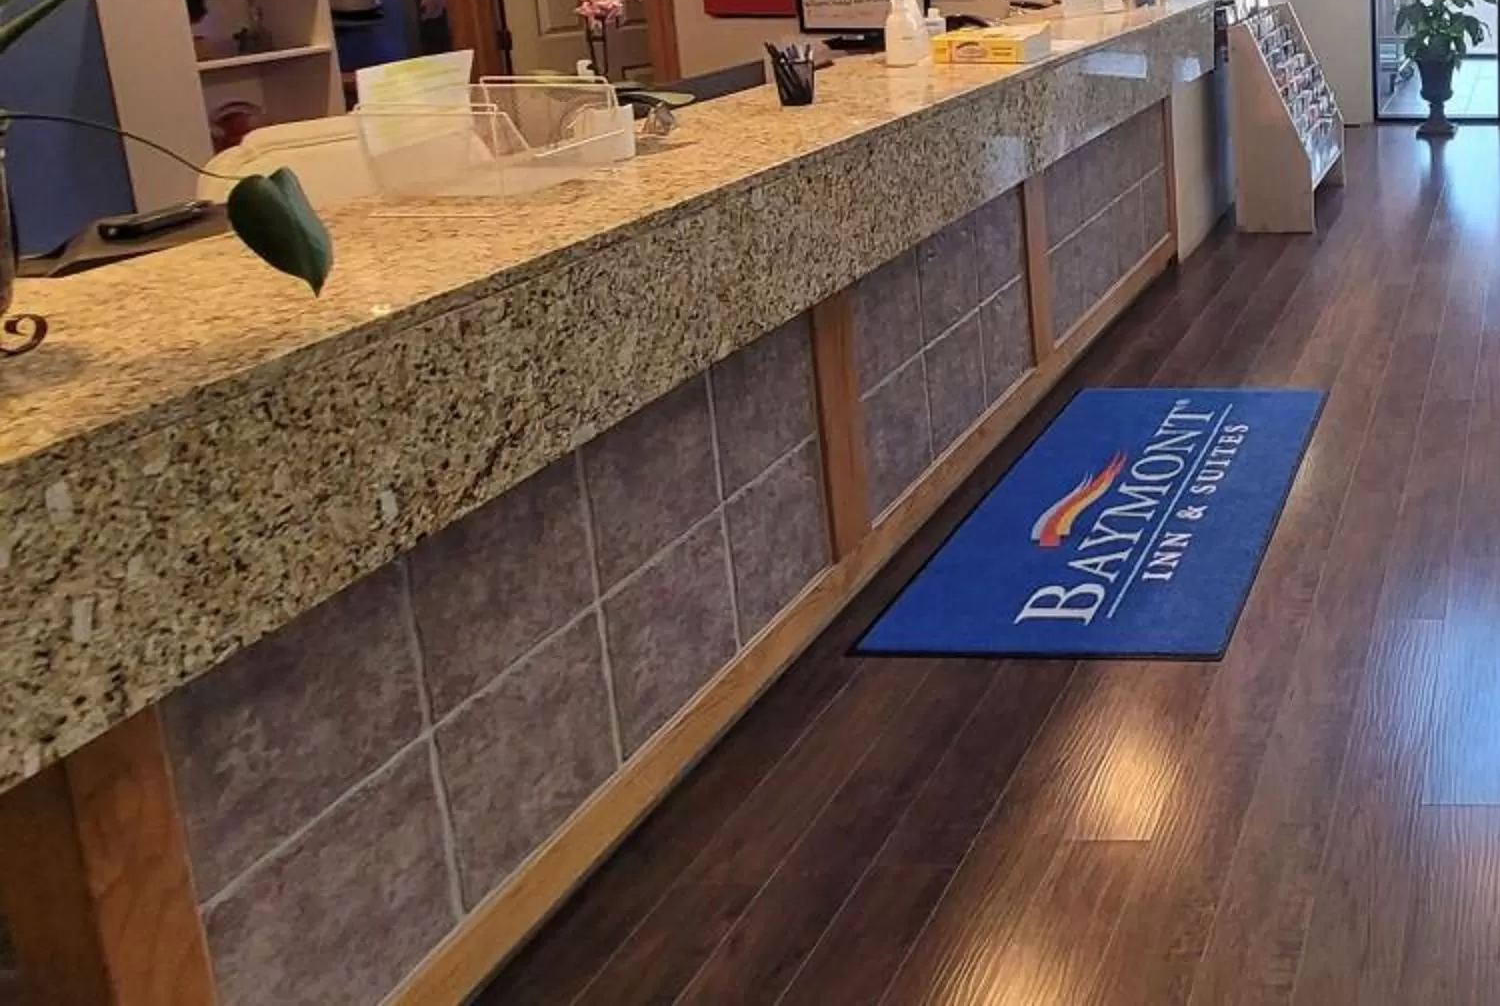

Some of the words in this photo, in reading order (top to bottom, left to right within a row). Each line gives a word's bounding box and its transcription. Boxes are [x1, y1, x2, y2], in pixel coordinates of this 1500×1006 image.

[1190, 422, 1250, 496] SUITES
[1013, 404, 1215, 626] BAYMONT
[1176, 504, 1209, 520] &
[1141, 531, 1193, 582] INN
